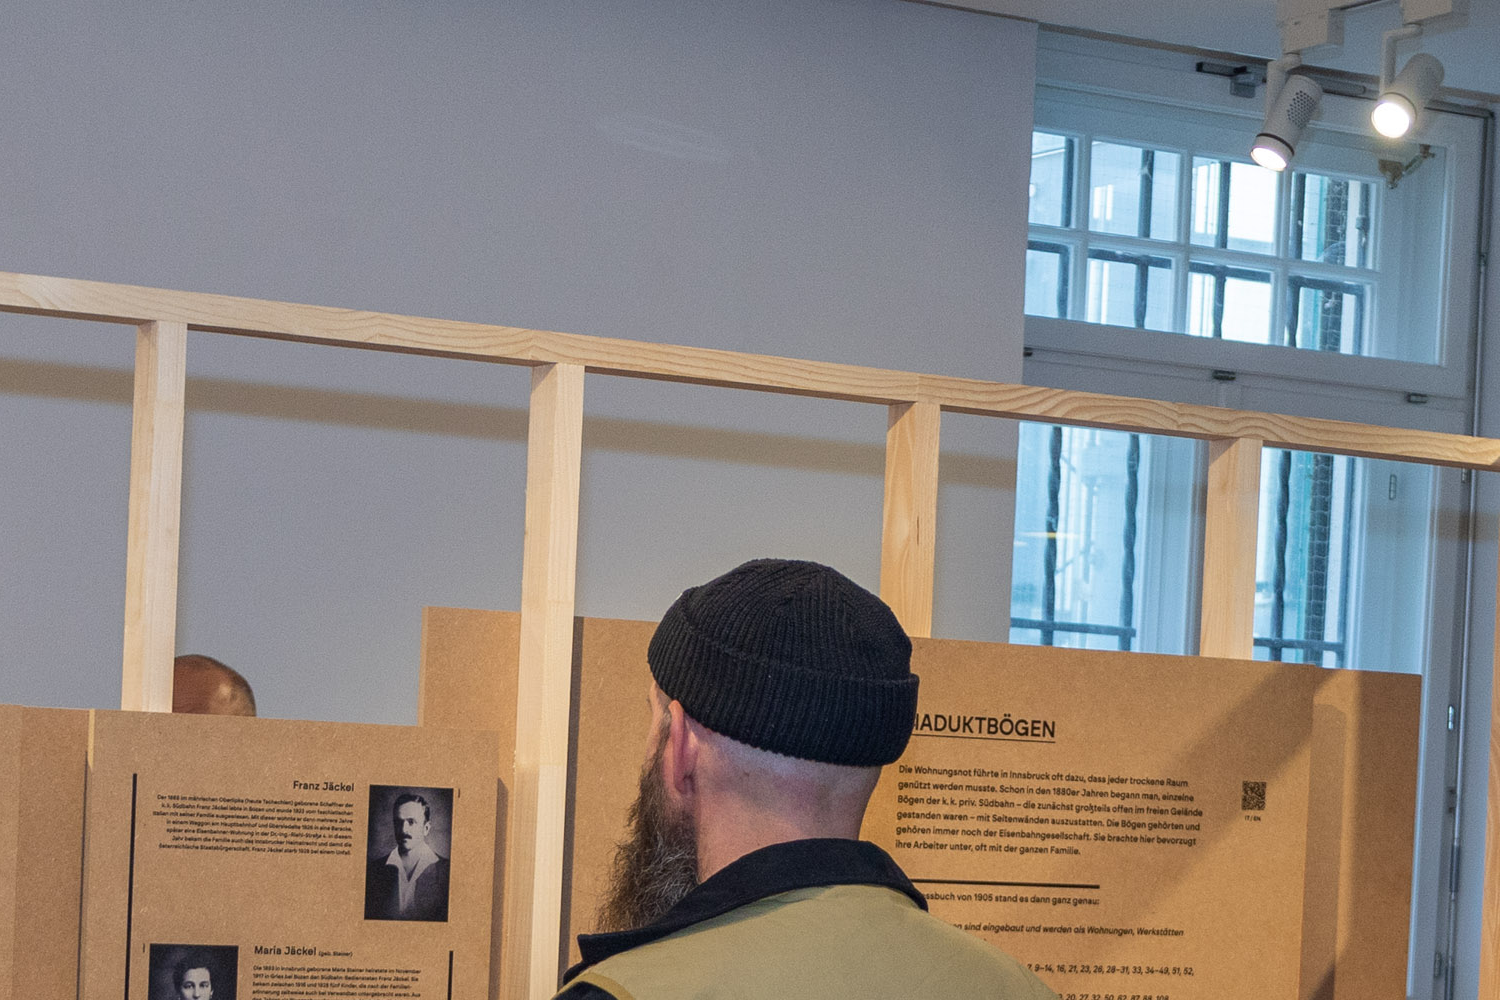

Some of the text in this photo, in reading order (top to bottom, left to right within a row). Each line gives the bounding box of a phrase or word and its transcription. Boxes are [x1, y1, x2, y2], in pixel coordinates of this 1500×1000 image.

[912, 713, 1056, 738] IADUKTBÖGEN
[898, 764, 1188, 787] Die Wohnungsnot führte in Innsbruck oft dazu, dass jeder trockene Raum
[292, 780, 354, 792] Franz Jäckel
[897, 780, 1194, 802] genützt werden musste. Schon in den 1880er Jahren begann man, einzelne
[895, 825, 1196, 847] gehören immer noch der Eisenbahngesellschaft. Sie brachte hier bevorzugt
[895, 839, 1080, 855] ihre Arbeiter unter, oft mit der ganzen Familie.
[924, 892, 955, 900] ssbuch
[974, 893, 993, 902] 1905
[994, 894, 1018, 903] stand
[1029, 895, 1050, 903] dann
[1051, 897, 1071, 906] ganz
[1072, 898, 1099, 907] genau:
[964, 922, 1184, 936] sind eingebaut und werden als Wohnungen, Werkstätten
[254, 945, 316, 956] Maria Jäckel
